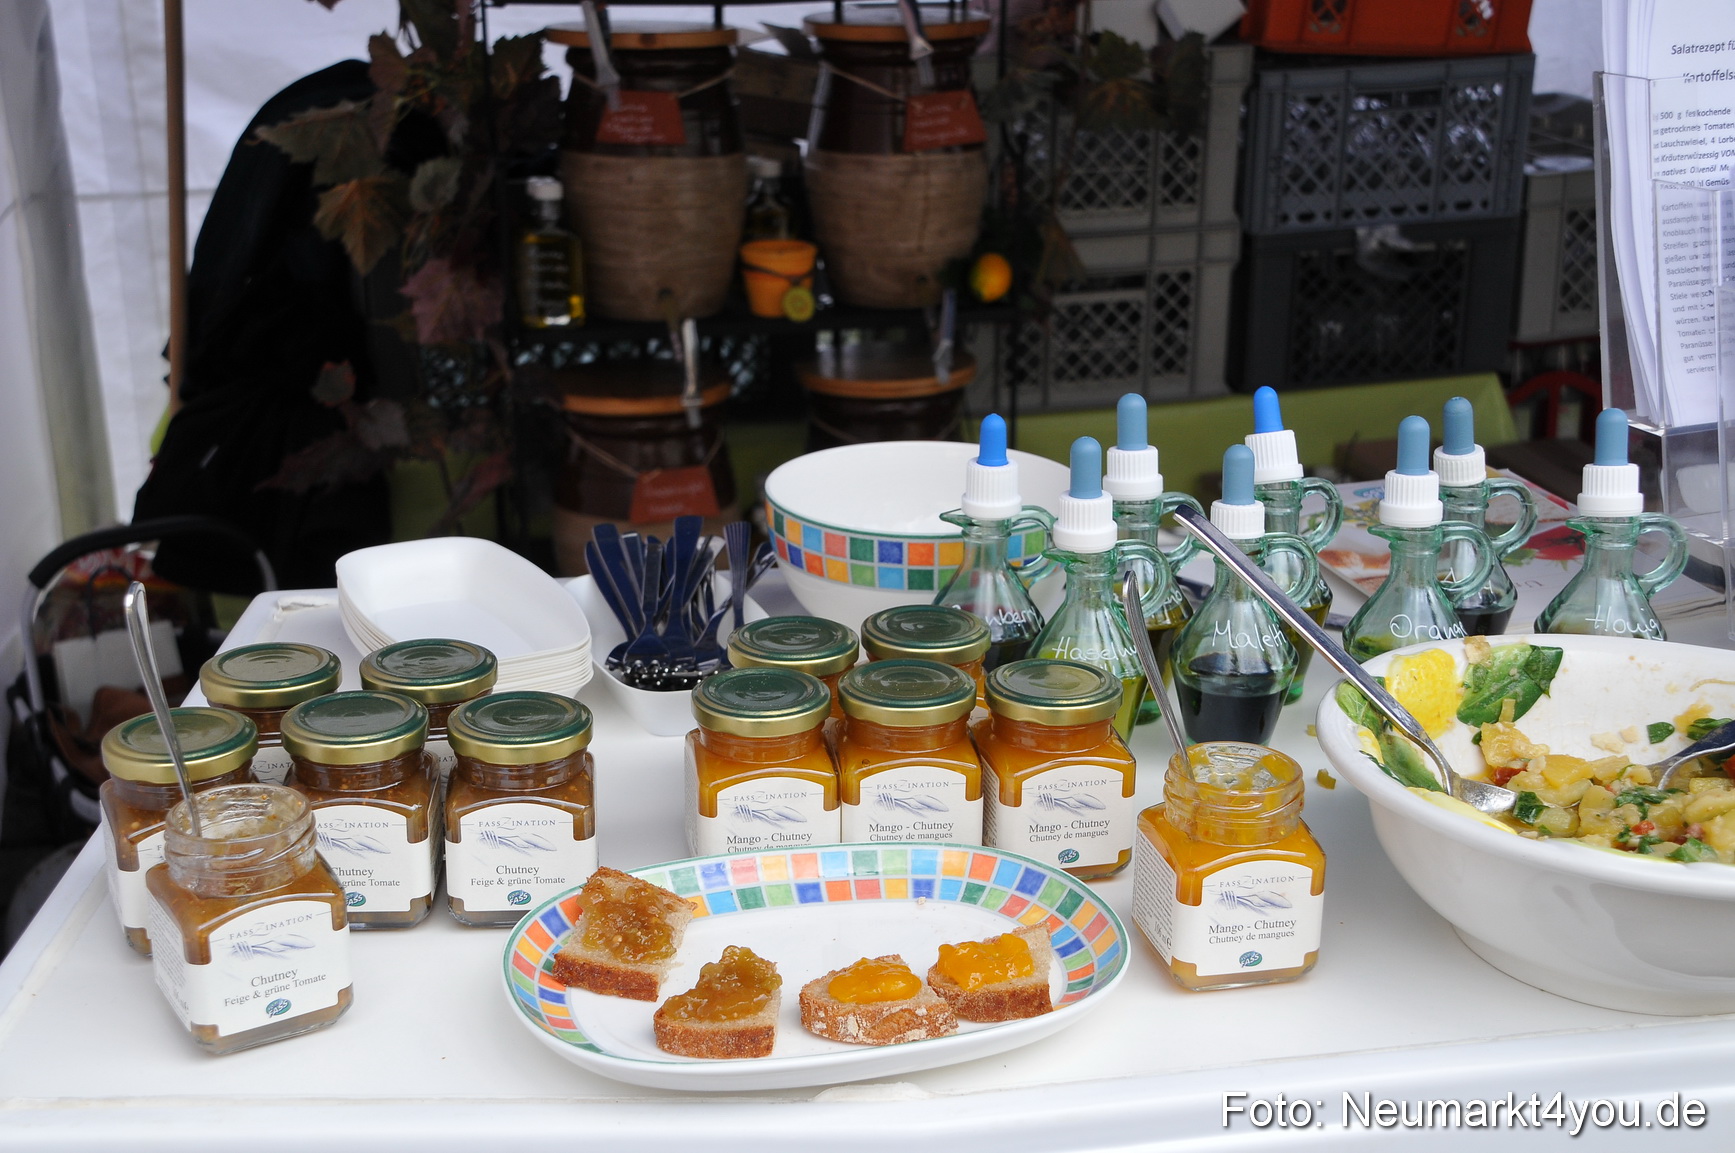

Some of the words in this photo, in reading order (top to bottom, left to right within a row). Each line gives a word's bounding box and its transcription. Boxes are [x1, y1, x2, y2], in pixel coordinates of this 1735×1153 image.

[1671, 42, 1724, 55] Salatrezept
[316, 818, 390, 832] ASSZINATION
[868, 824, 904, 834] Mango
[912, 821, 954, 832] Chutney
[1028, 824, 1062, 834] Mango
[1070, 820, 1111, 830] Chutney
[726, 835, 762, 846] Mango
[771, 832, 813, 842] Chutney
[870, 834, 904, 842] Chutney
[906, 832, 915, 840] de
[917, 832, 953, 841] mangues
[1029, 834, 1062, 843] Chutney
[1074, 830, 1109, 838] mangues
[496, 865, 540, 876] Chutney
[342, 878, 366, 890] grüne
[368, 878, 401, 887] Tomate
[471, 878, 494, 888] Feige
[496, 877, 506, 886] &
[507, 878, 532, 886] grüne
[534, 876, 566, 884] Tomate
[1208, 924, 1244, 935] Mango
[1254, 920, 1297, 930] Chutney
[1208, 935, 1244, 944] Chutney
[1246, 932, 1256, 940] de
[1258, 930, 1295, 940] mangues
[251, 968, 299, 988] Chutney
[224, 993, 250, 1008] Feige
[252, 990, 262, 1000] &
[264, 982, 290, 998] grüne
[292, 973, 328, 988] Tomate
